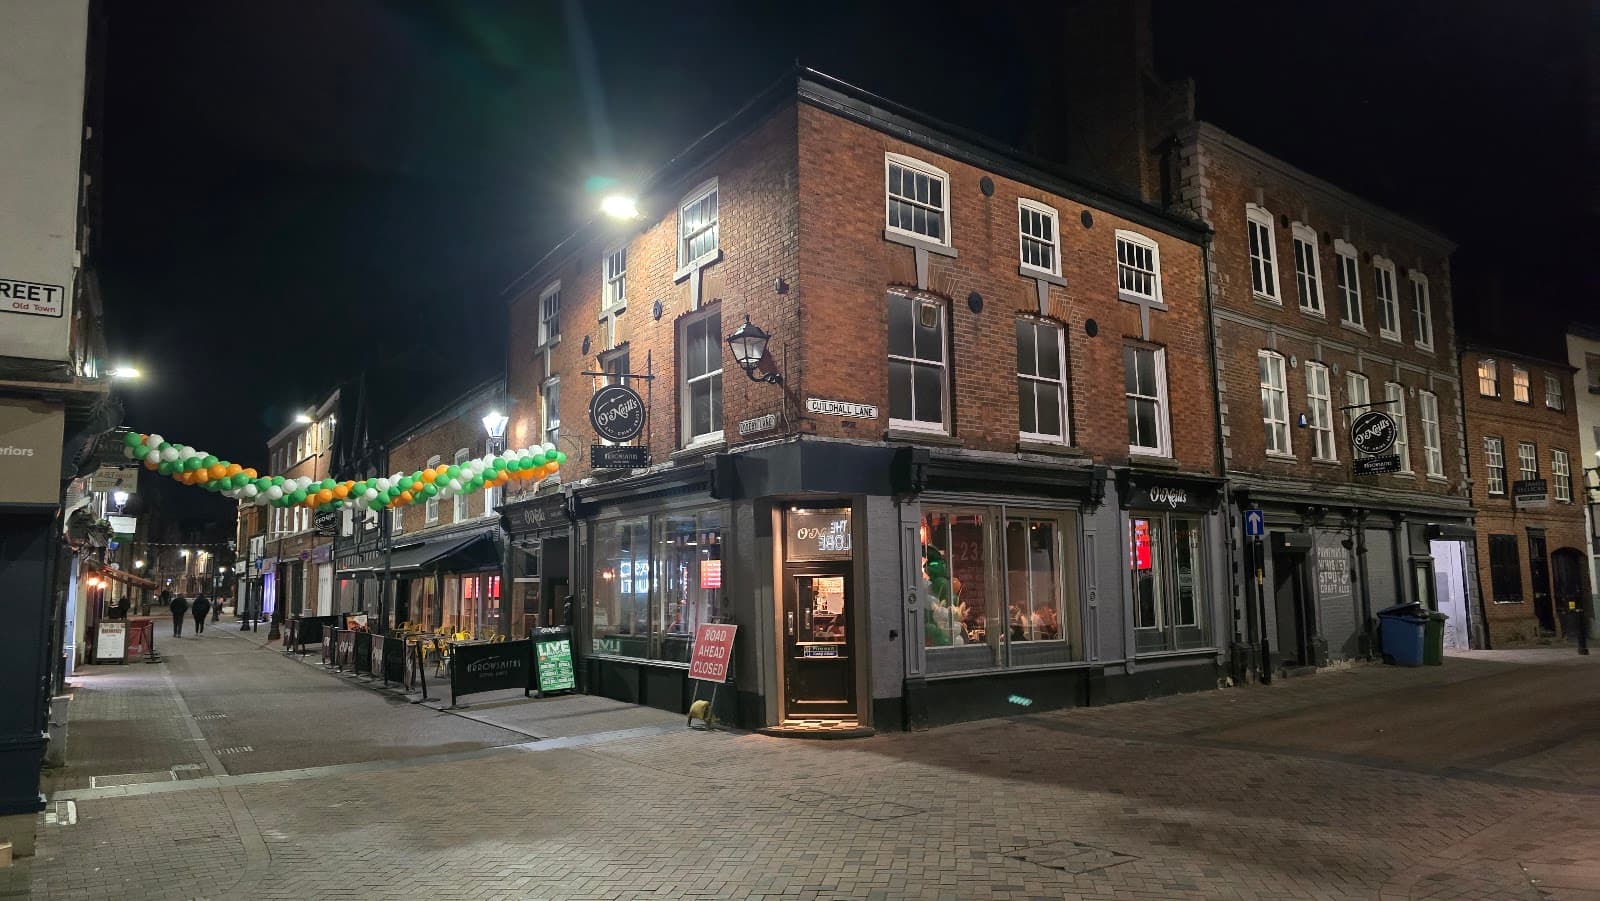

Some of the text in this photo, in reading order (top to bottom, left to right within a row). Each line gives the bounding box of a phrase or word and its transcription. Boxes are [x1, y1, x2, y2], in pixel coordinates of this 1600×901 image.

[0, 282, 57, 303] REET
[12, 302, 56, 313] Old Town
[598, 398, 637, 425] O'Neill's
[812, 401, 873, 417] GUILDHALL LANE
[1355, 419, 1390, 445] O'Neill's
[1150, 486, 1187, 508] O'Neill's
[704, 629, 727, 642] ROAD
[538, 640, 570, 657] LIVE
[698, 645, 725, 659] AHEAD
[693, 661, 724, 676] CLOSED
